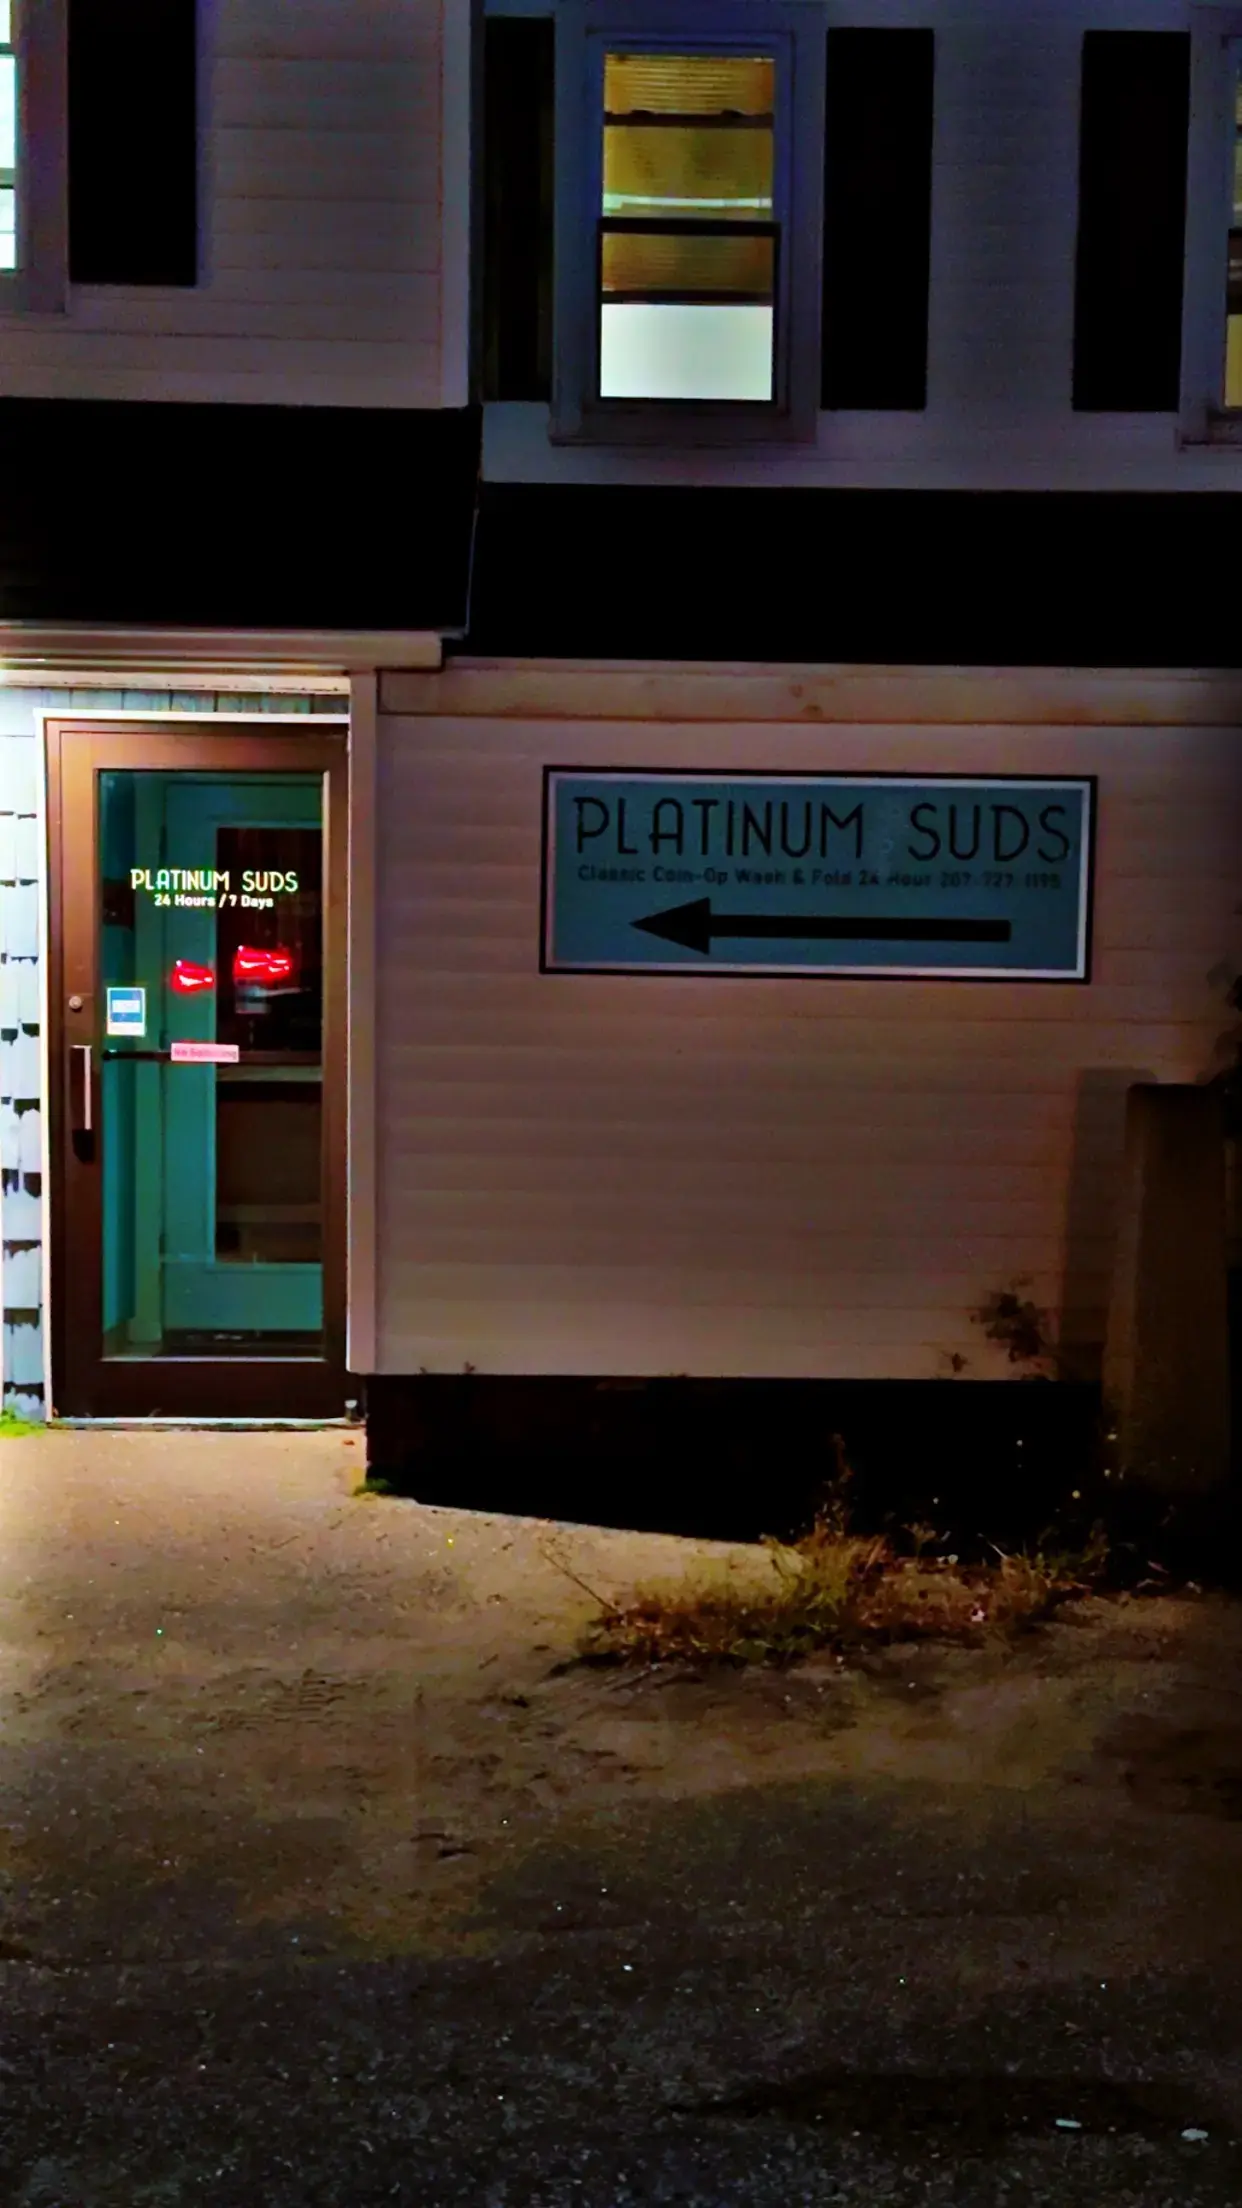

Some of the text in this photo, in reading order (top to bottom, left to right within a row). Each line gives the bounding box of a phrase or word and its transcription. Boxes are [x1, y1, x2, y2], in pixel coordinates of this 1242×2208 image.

[572, 797, 1072, 862] PLATINUM SUDS
[130, 869, 298, 892] PLATINUM SUDS
[578, 864, 646, 883] Classic
[792, 867, 806, 885] &
[812, 868, 852, 885] Fold
[154, 893, 171, 906] 24
[174, 894, 216, 907] Hours
[240, 895, 274, 910] Days
